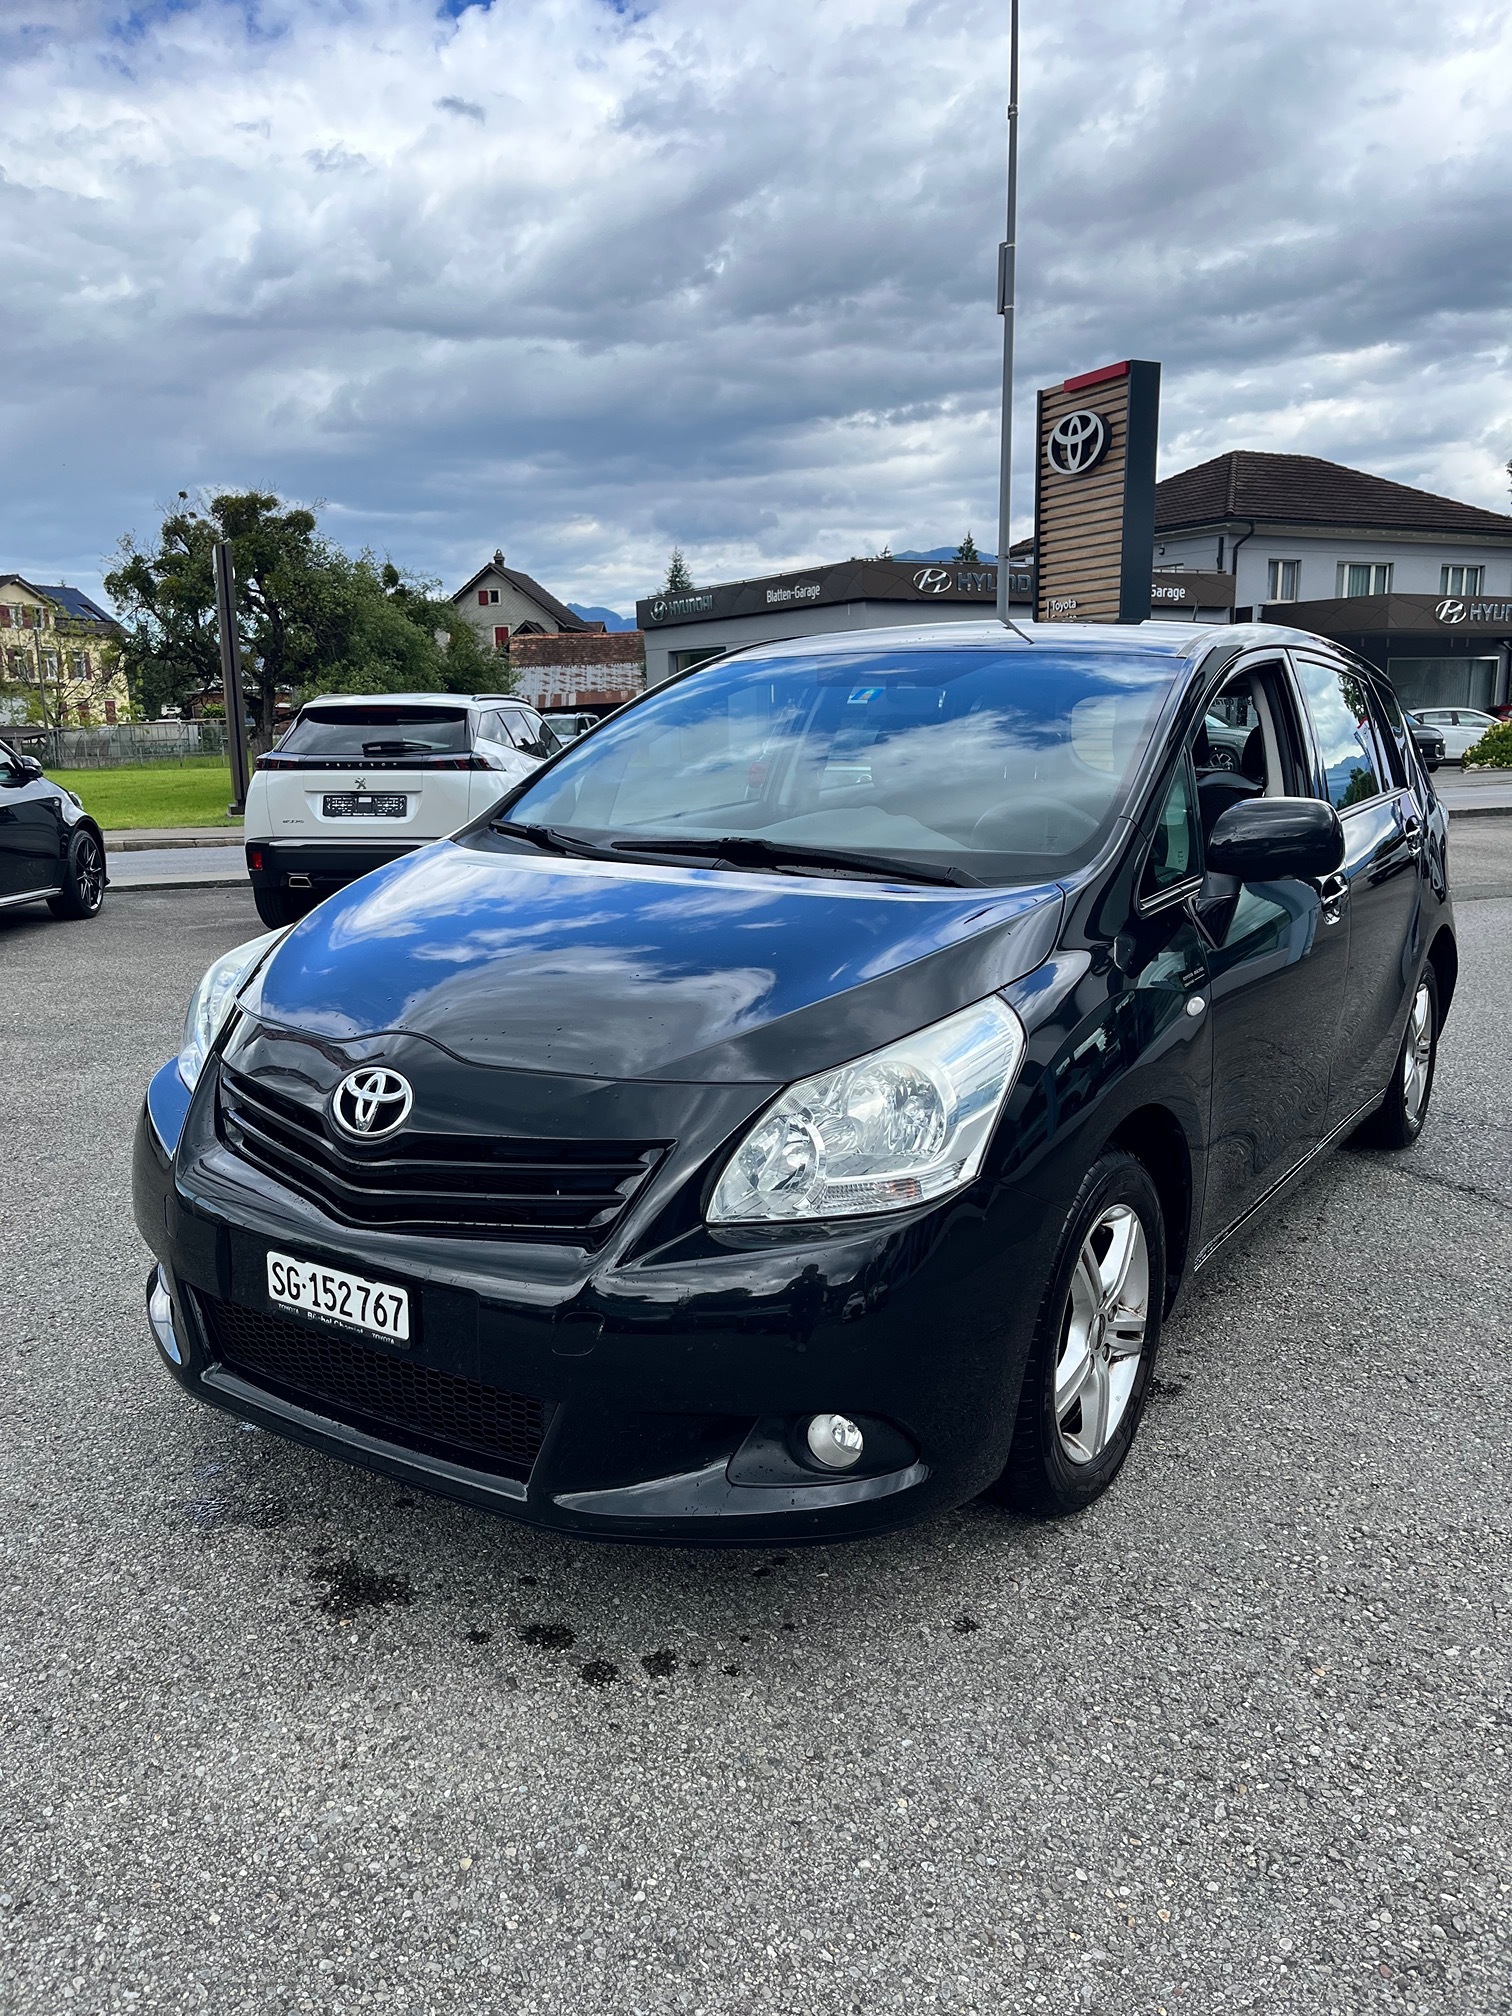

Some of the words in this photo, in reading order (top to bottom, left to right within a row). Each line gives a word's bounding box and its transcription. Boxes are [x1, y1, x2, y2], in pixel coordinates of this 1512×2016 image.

[766, 584, 821, 603] Blatten-Garage
[669, 594, 713, 616] HYUNDAI
[1051, 599, 1077, 612] Toyota
